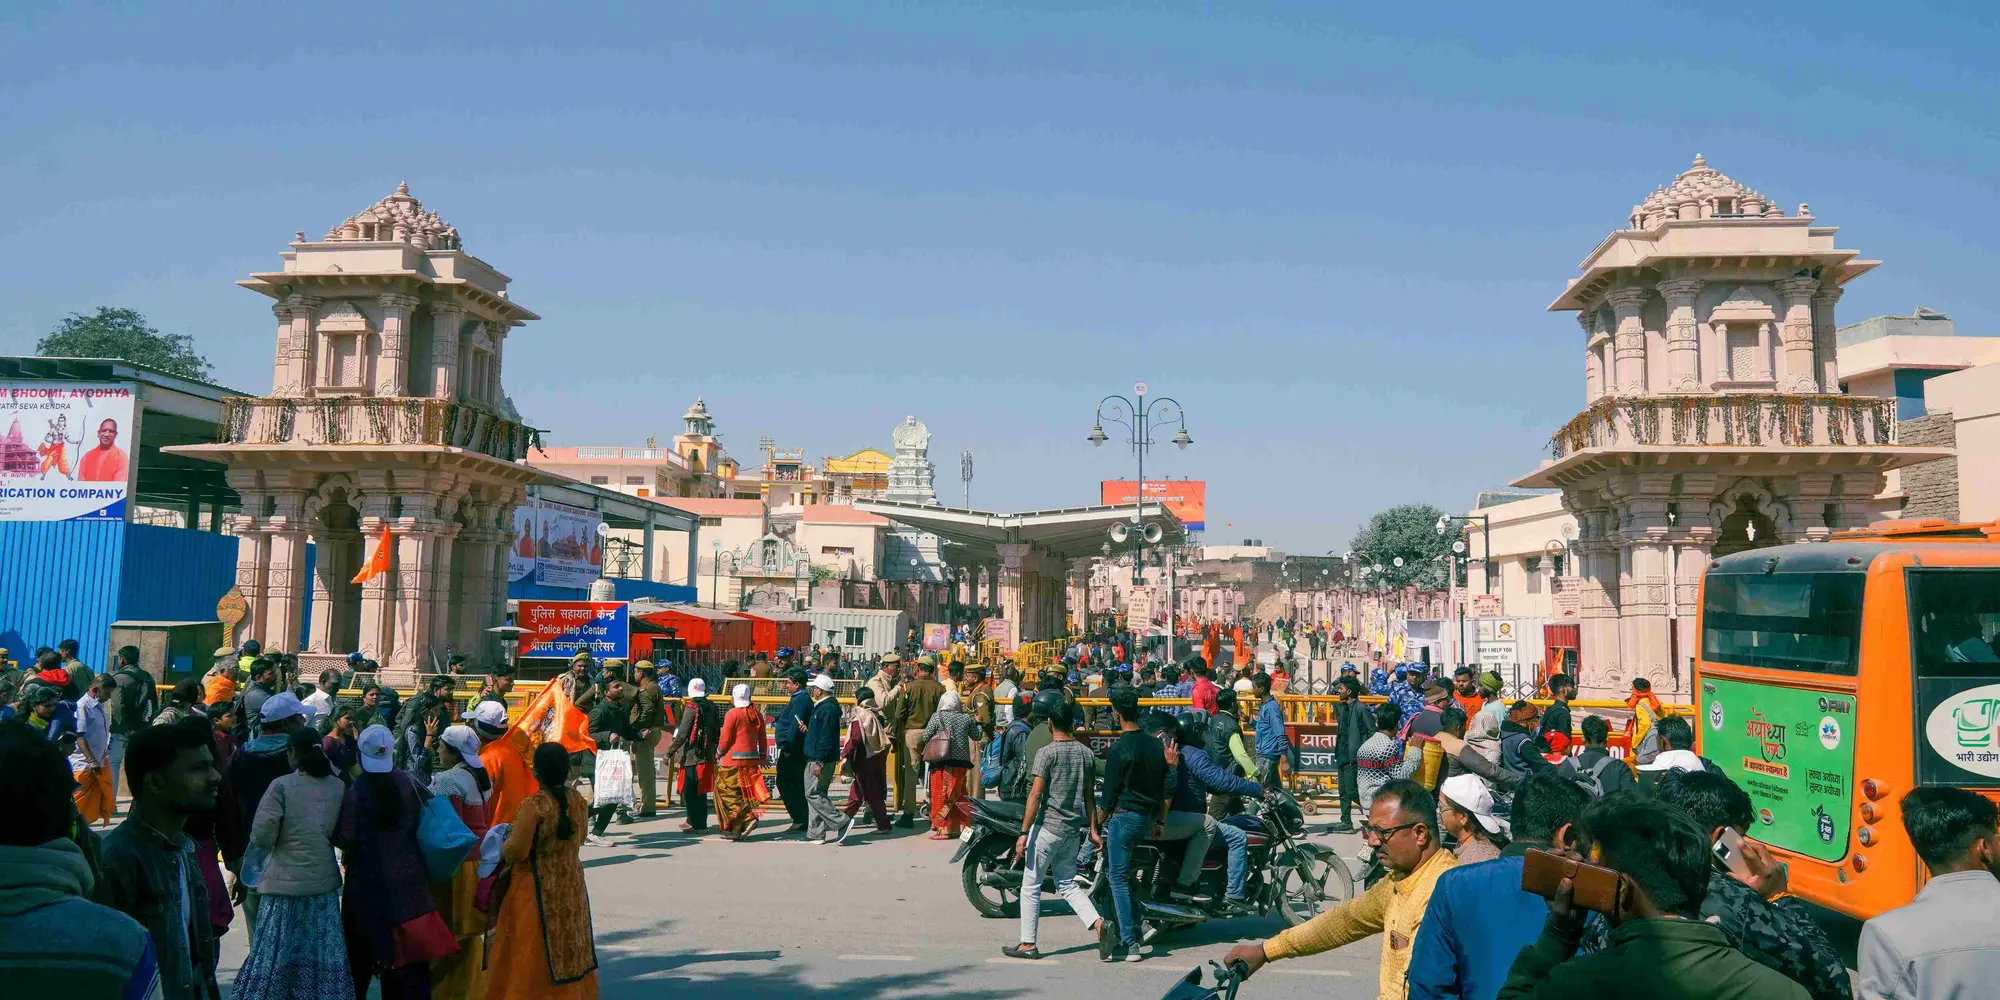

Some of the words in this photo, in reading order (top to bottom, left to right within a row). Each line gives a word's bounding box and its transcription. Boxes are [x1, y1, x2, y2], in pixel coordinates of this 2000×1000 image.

[11, 389, 66, 399] BHOOMI,
[70, 388, 130, 398] AYODHYA
[60, 489, 123, 499] COMPANY
[530, 605, 555, 623] पुलिस
[560, 609, 592, 621] सहायता
[596, 606, 616, 621] केन्द्र
[538, 624, 561, 634] Police
[563, 624, 580, 637] Help
[582, 624, 608, 635] Center
[530, 638, 553, 651] श्रीराम
[589, 639, 615, 651] परिसर
[1745, 706, 1786, 743] अयोध्या
[1300, 734, 1337, 748] याता
[1300, 752, 1336, 766] जन
[1956, 751, 1974, 762] भारी
[1976, 751, 1999, 762] उद्योग
